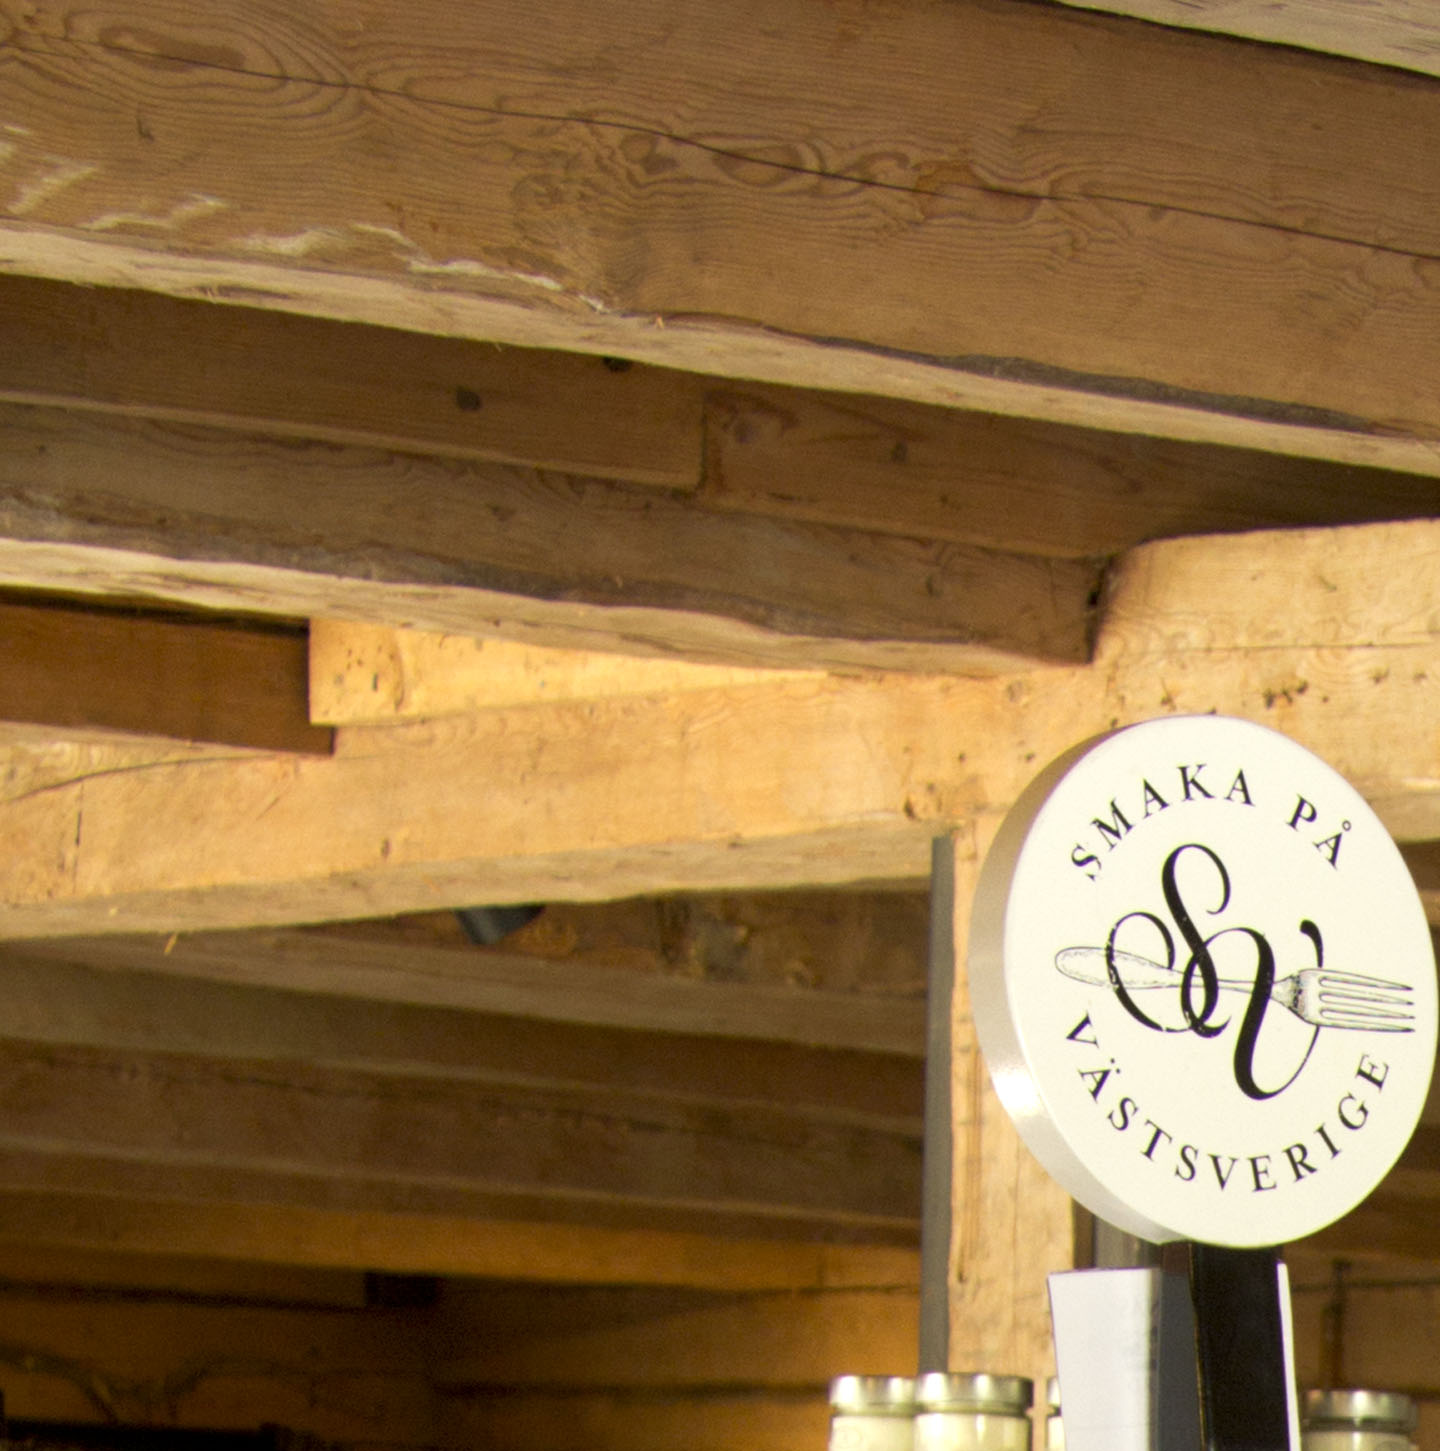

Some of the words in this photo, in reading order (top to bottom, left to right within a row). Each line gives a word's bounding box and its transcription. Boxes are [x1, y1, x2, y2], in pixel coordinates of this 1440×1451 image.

[1071, 763, 1256, 881] SMAKA
[1287, 794, 1352, 870] PÅ
[1066, 1052, 1390, 1192] VÄSTSVERIGE
